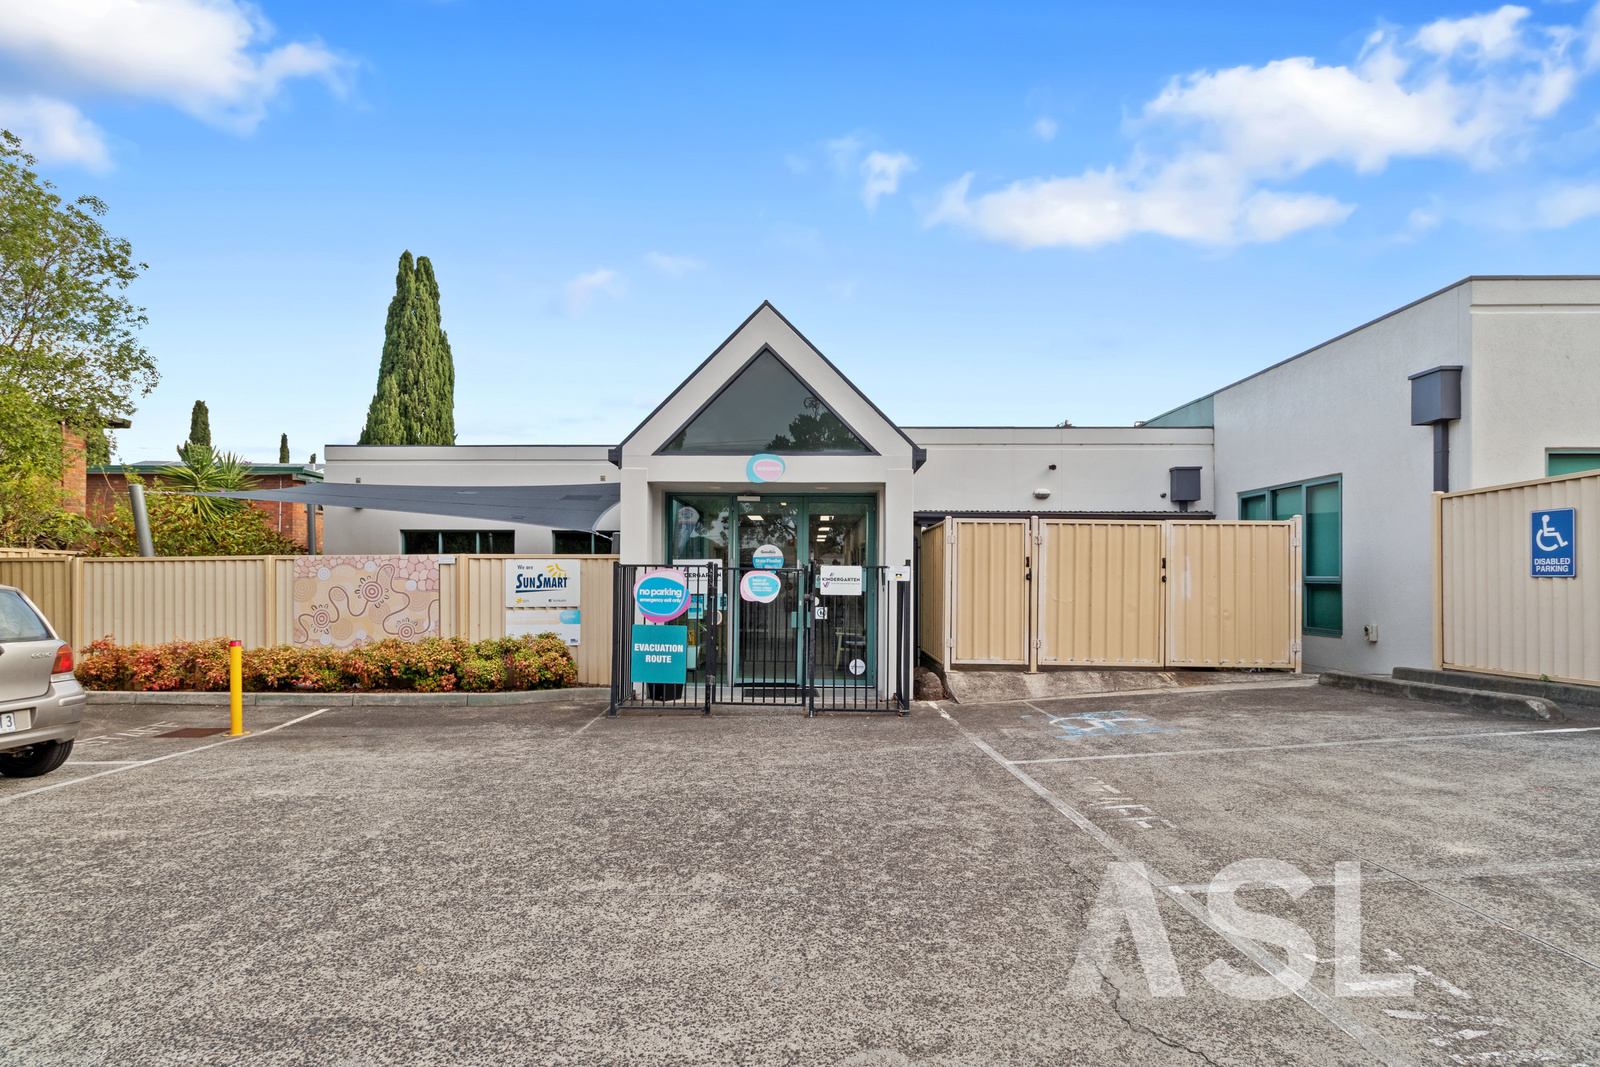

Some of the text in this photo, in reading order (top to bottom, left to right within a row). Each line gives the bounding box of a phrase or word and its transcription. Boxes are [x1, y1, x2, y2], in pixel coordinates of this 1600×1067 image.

[1534, 557, 1570, 565] DISABLED
[650, 588, 682, 598] parking
[634, 643, 684, 652] EVACUATION
[645, 655, 672, 663] ROUTE
